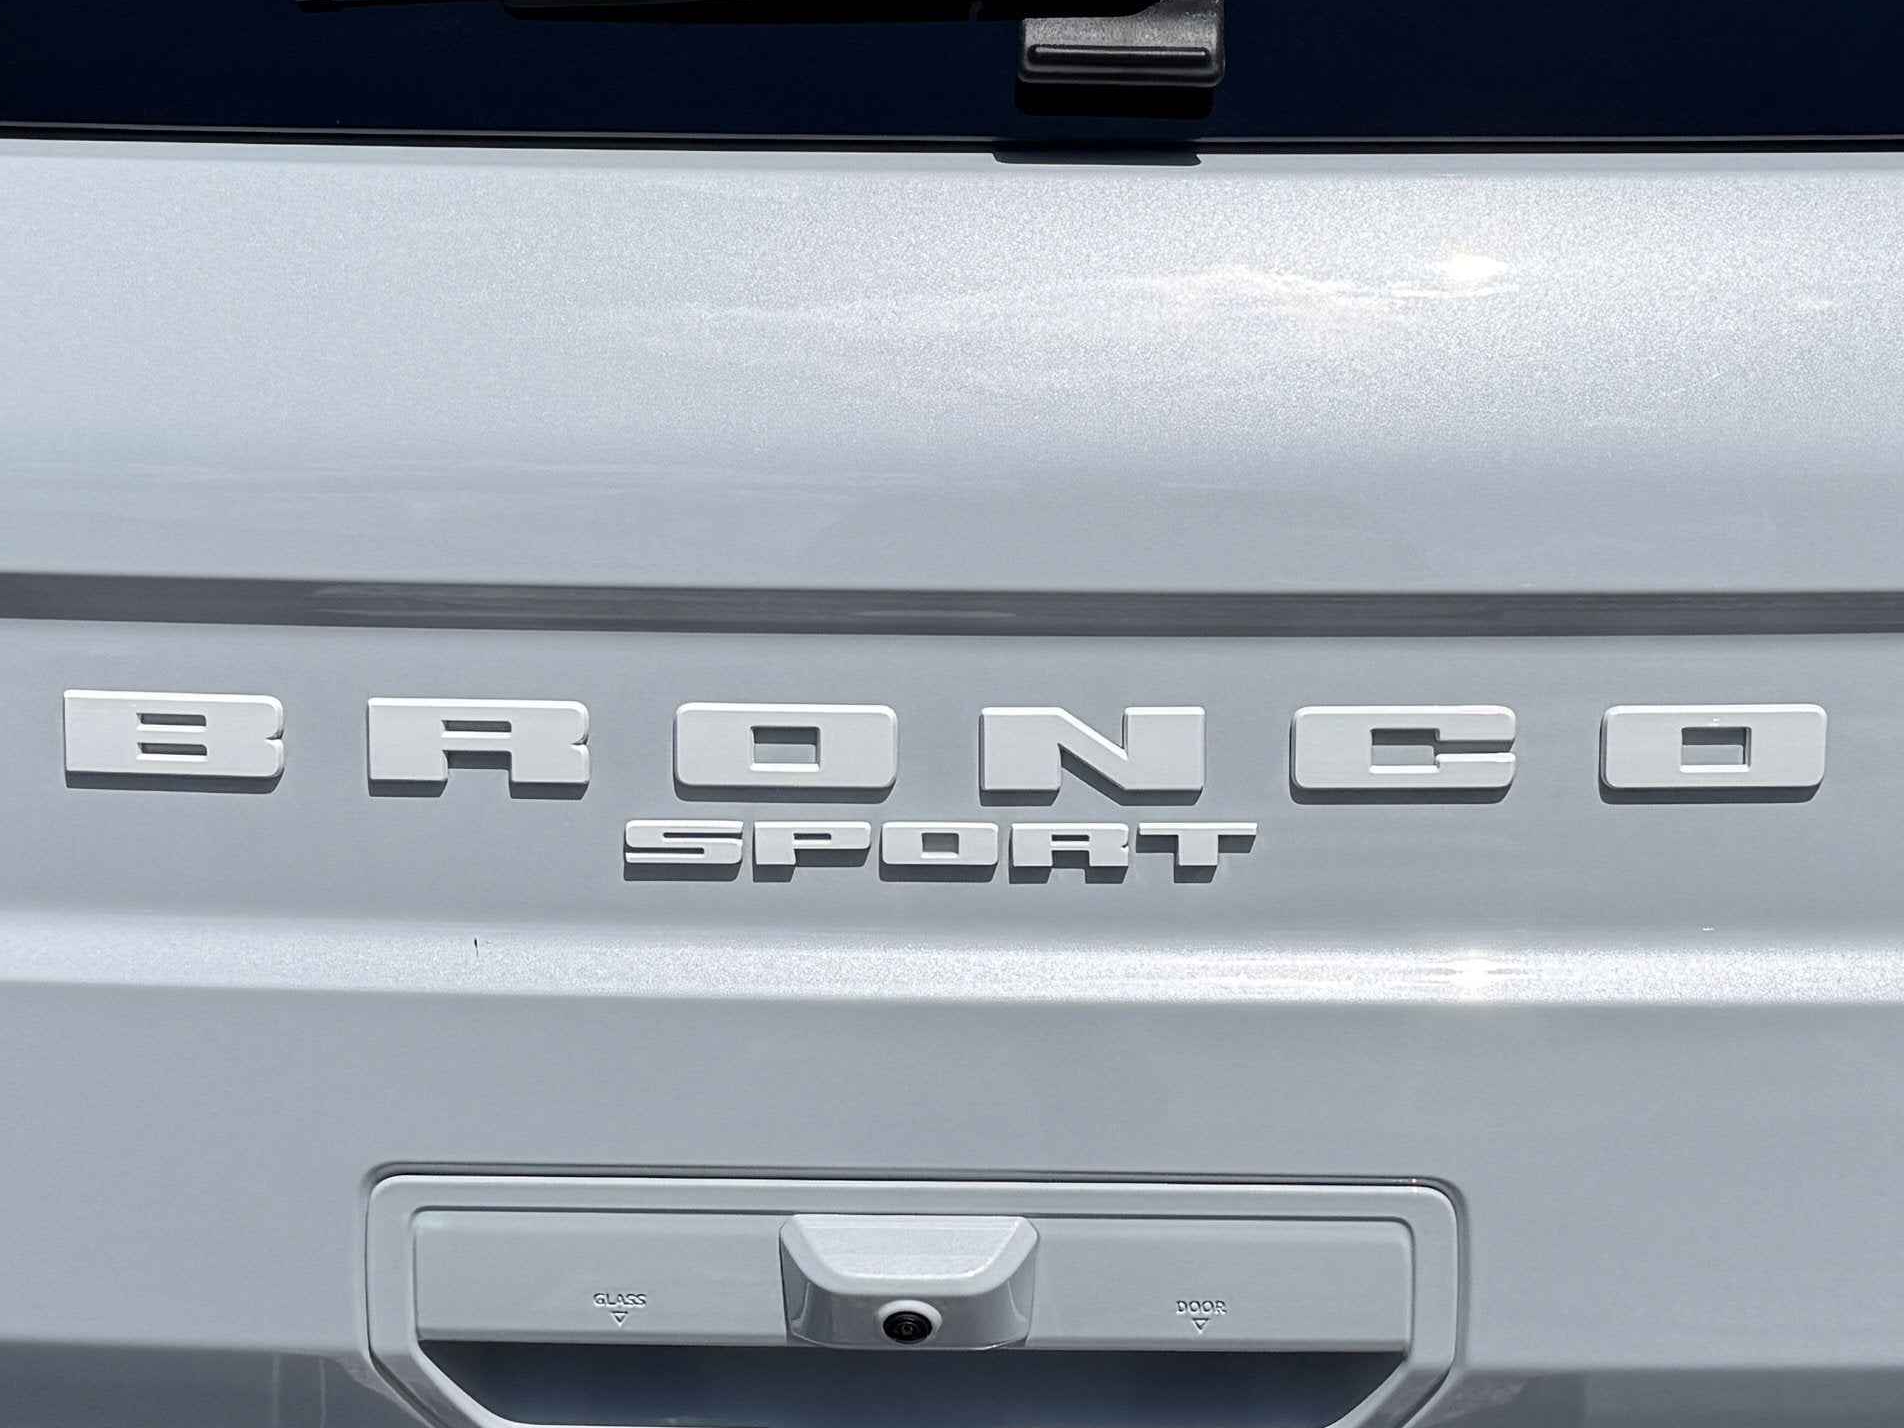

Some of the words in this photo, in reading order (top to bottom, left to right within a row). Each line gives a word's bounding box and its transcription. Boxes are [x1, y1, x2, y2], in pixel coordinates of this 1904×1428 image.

[63, 688, 1828, 798] BRONCO
[624, 818, 1258, 880] SPORT
[593, 1293, 647, 1307] GLASS
[1176, 1300, 1227, 1315] DOOR
